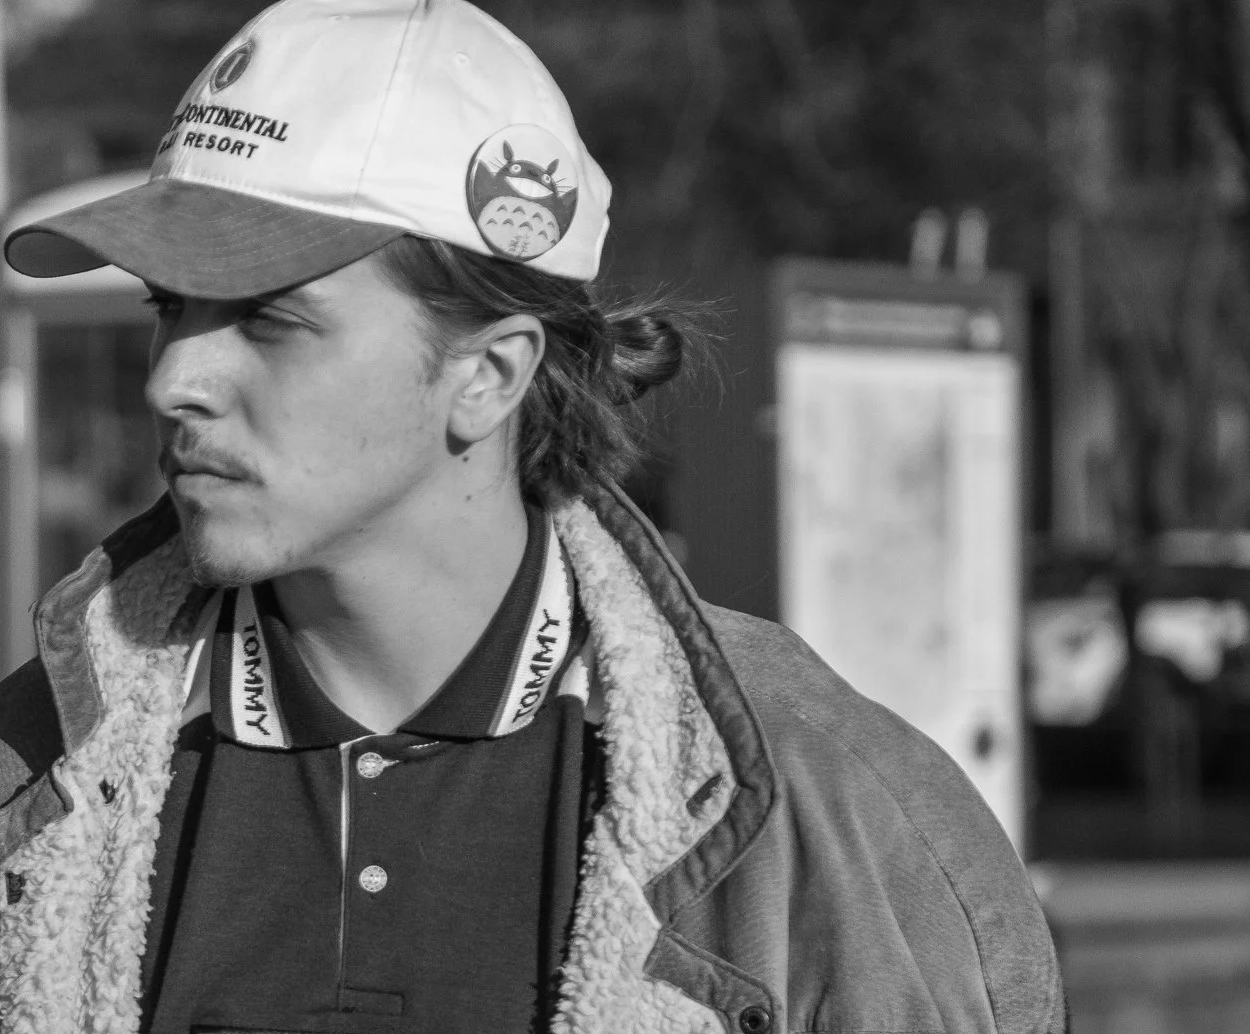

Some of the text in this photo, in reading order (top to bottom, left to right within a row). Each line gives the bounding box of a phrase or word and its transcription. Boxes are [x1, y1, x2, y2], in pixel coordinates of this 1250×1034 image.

[183, 131, 259, 159] RESORT
[242, 624, 271, 736] TOMMY
[511, 608, 561, 724] TOMMY
